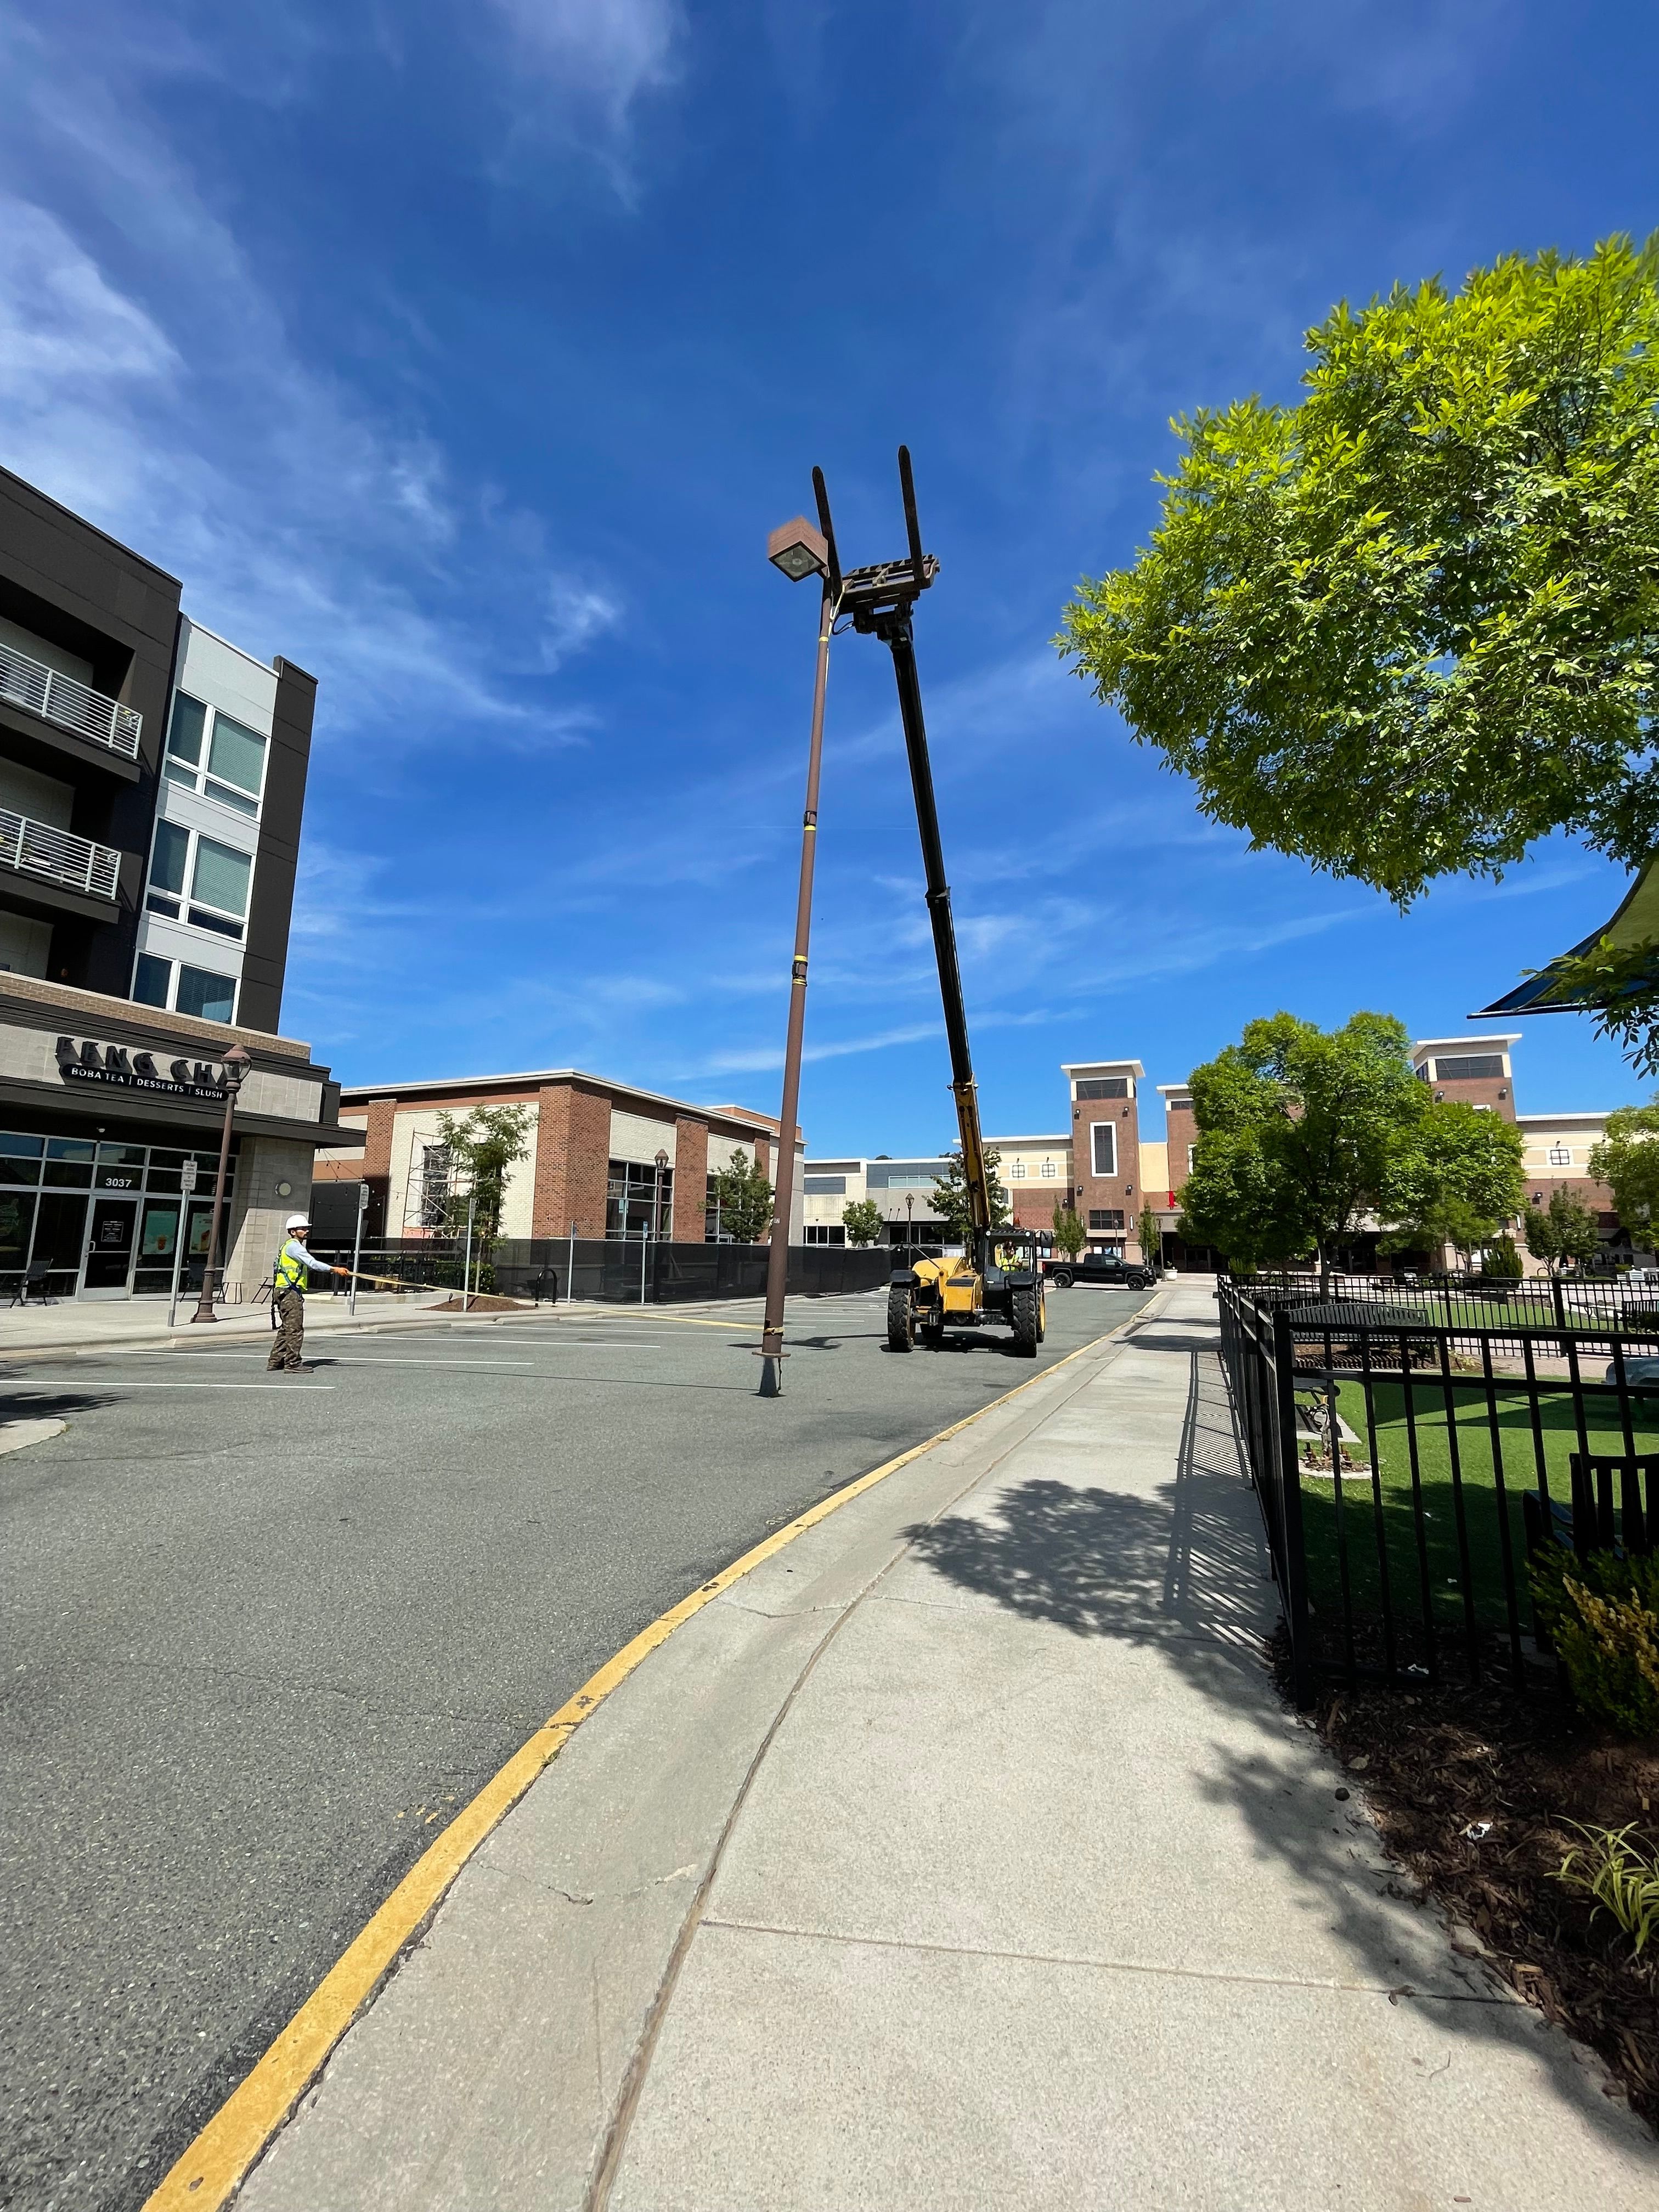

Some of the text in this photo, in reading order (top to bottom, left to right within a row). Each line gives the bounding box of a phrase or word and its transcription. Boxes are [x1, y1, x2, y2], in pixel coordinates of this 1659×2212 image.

[57, 1036, 232, 1088] FENG CH
[71, 1067, 223, 1099] BOBA TEA DESSERTS SLUSH
[105, 1177, 132, 1188] 3037
